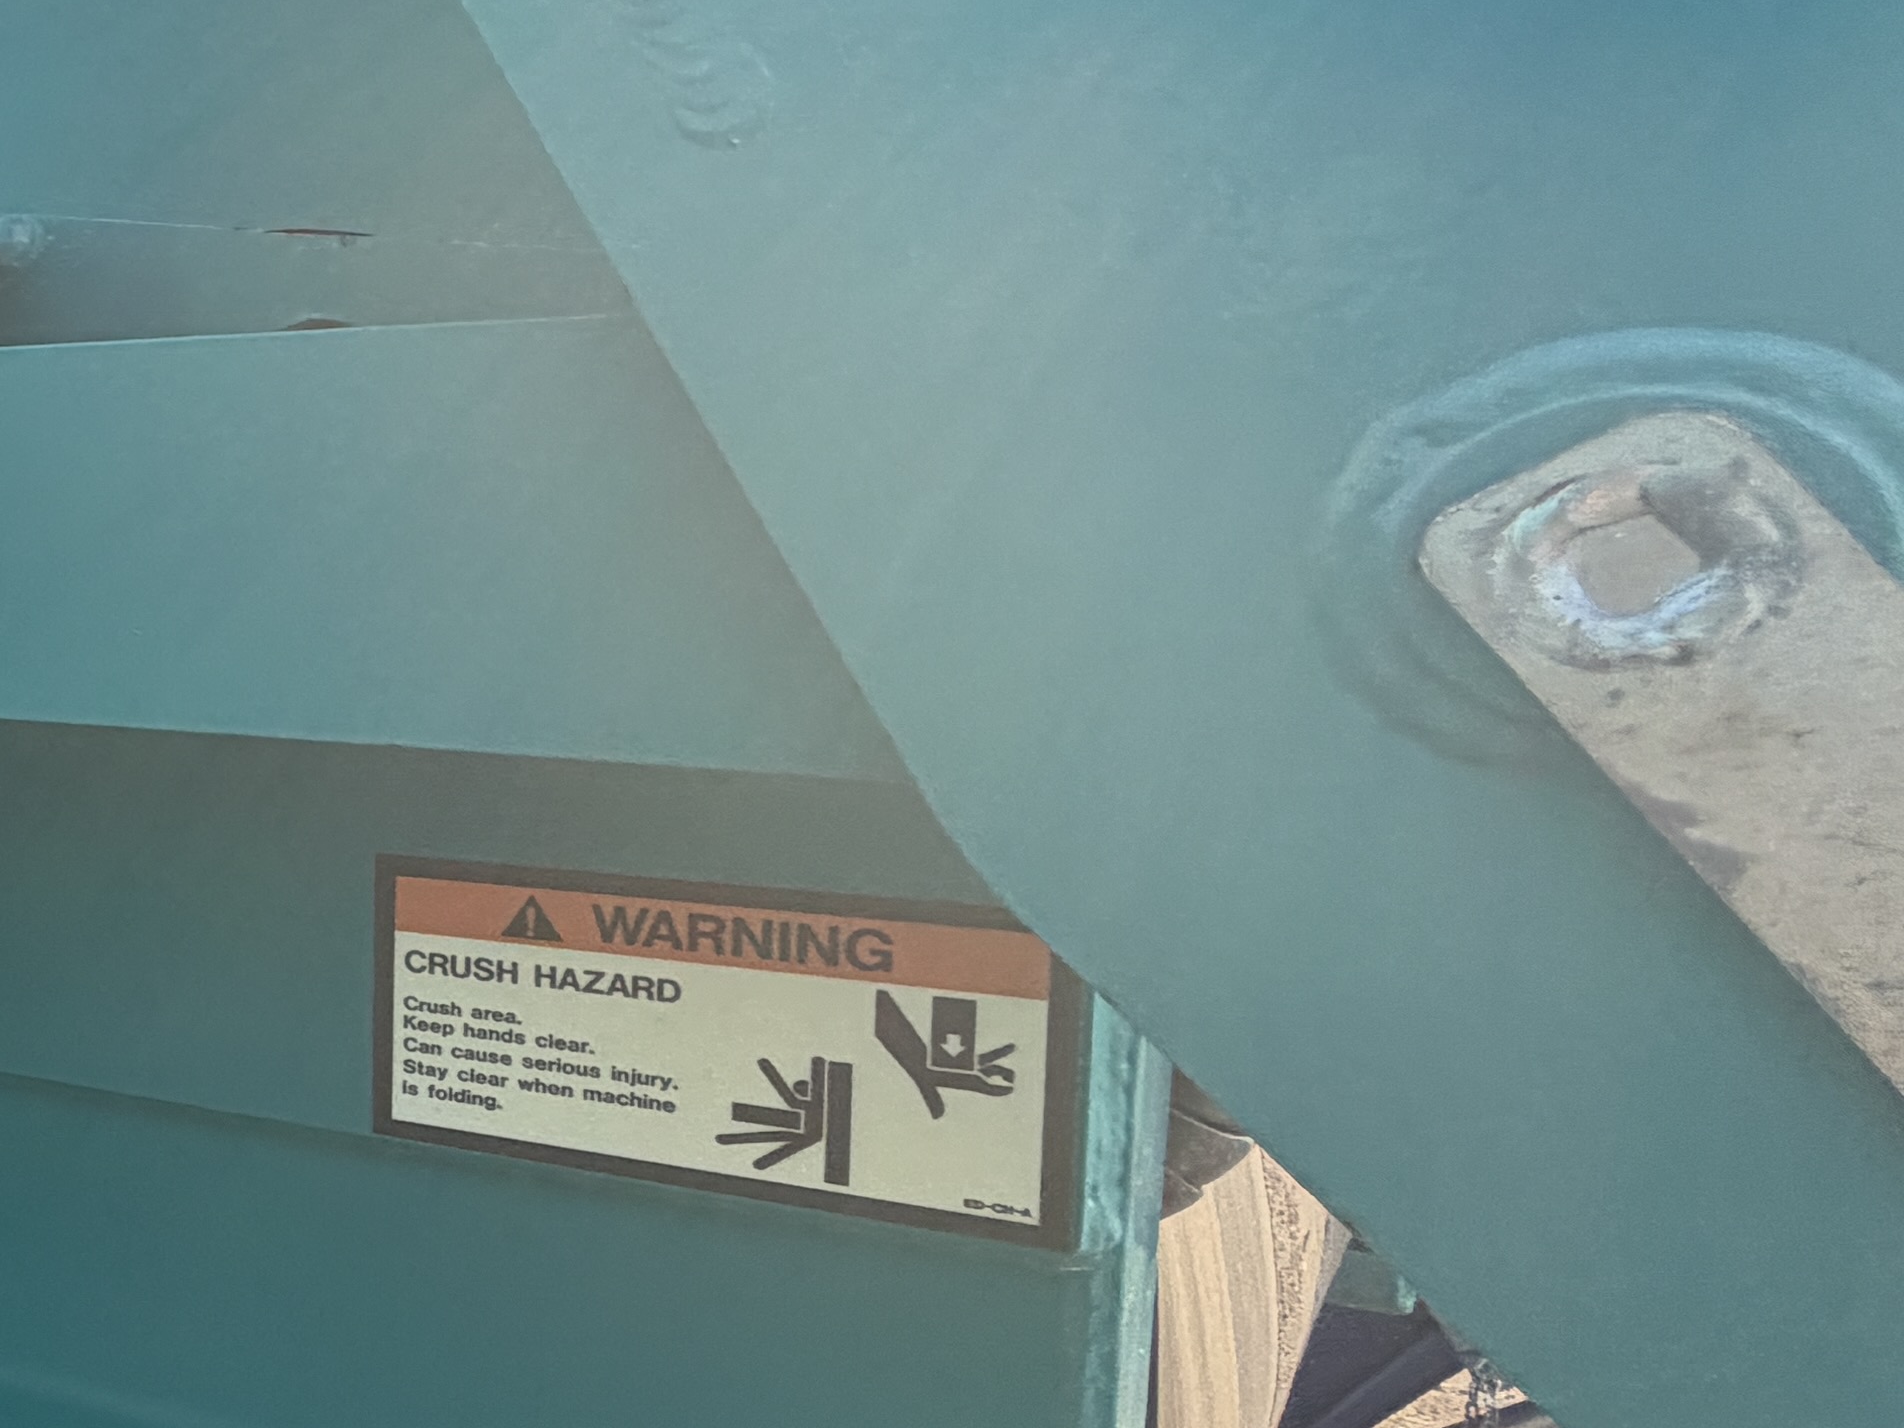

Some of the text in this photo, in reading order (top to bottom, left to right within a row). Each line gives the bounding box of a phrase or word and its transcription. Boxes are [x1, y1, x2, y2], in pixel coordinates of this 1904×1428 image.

[592, 904, 895, 972] WARNING
[404, 949, 682, 1003] CRUSH HAZARD
[403, 995, 522, 1025] Crush area.
[403, 1014, 595, 1055] Keep hands clear.
[402, 1058, 676, 1113] Stay clear when machine
[403, 1036, 679, 1091] Can cause serious injury.
[402, 1080, 503, 1111] is folding.
